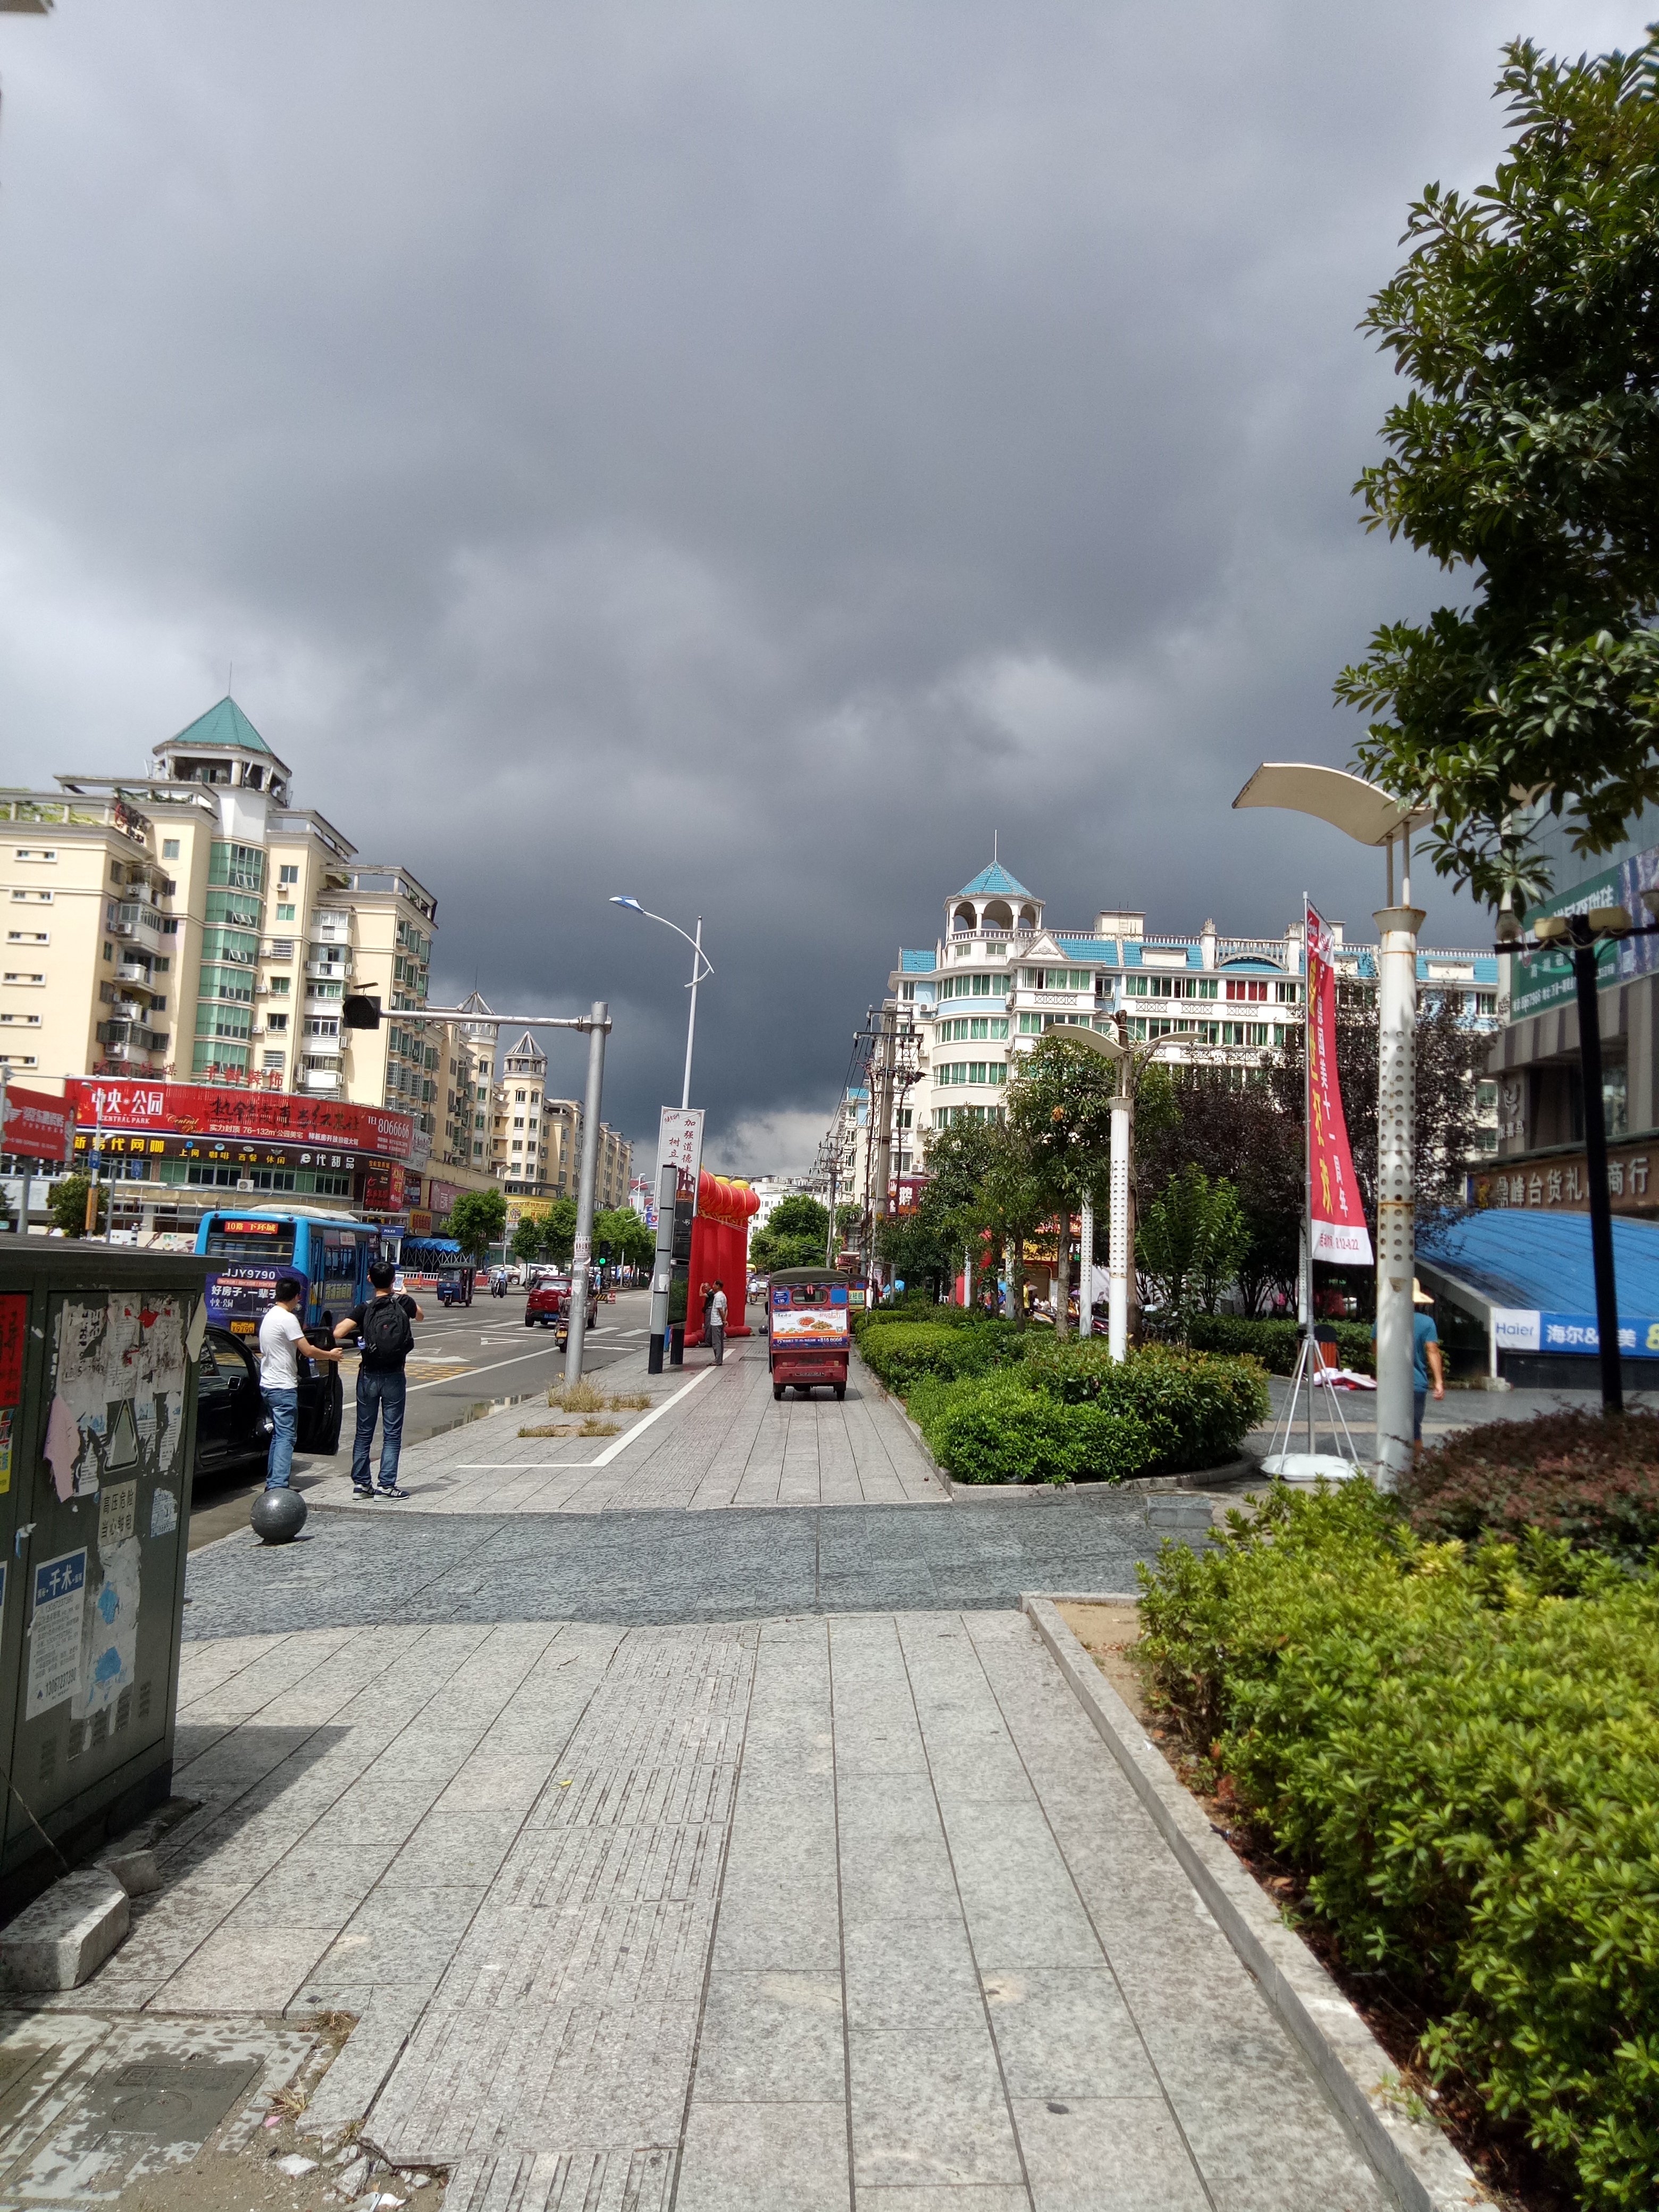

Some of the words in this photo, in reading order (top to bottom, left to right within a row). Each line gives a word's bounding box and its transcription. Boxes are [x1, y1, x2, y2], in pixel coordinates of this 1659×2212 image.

[368, 1116, 378, 1125] TEL
[179, 1149, 199, 1158] 上网
[209, 1151, 230, 1160] 咖啡
[239, 1153, 257, 1163] 西餐
[266, 1155, 286, 1165] 休闲
[1497, 1157, 1648, 1208] 鼎峰台货礼商行
[1496, 1322, 1534, 1336] Haier
